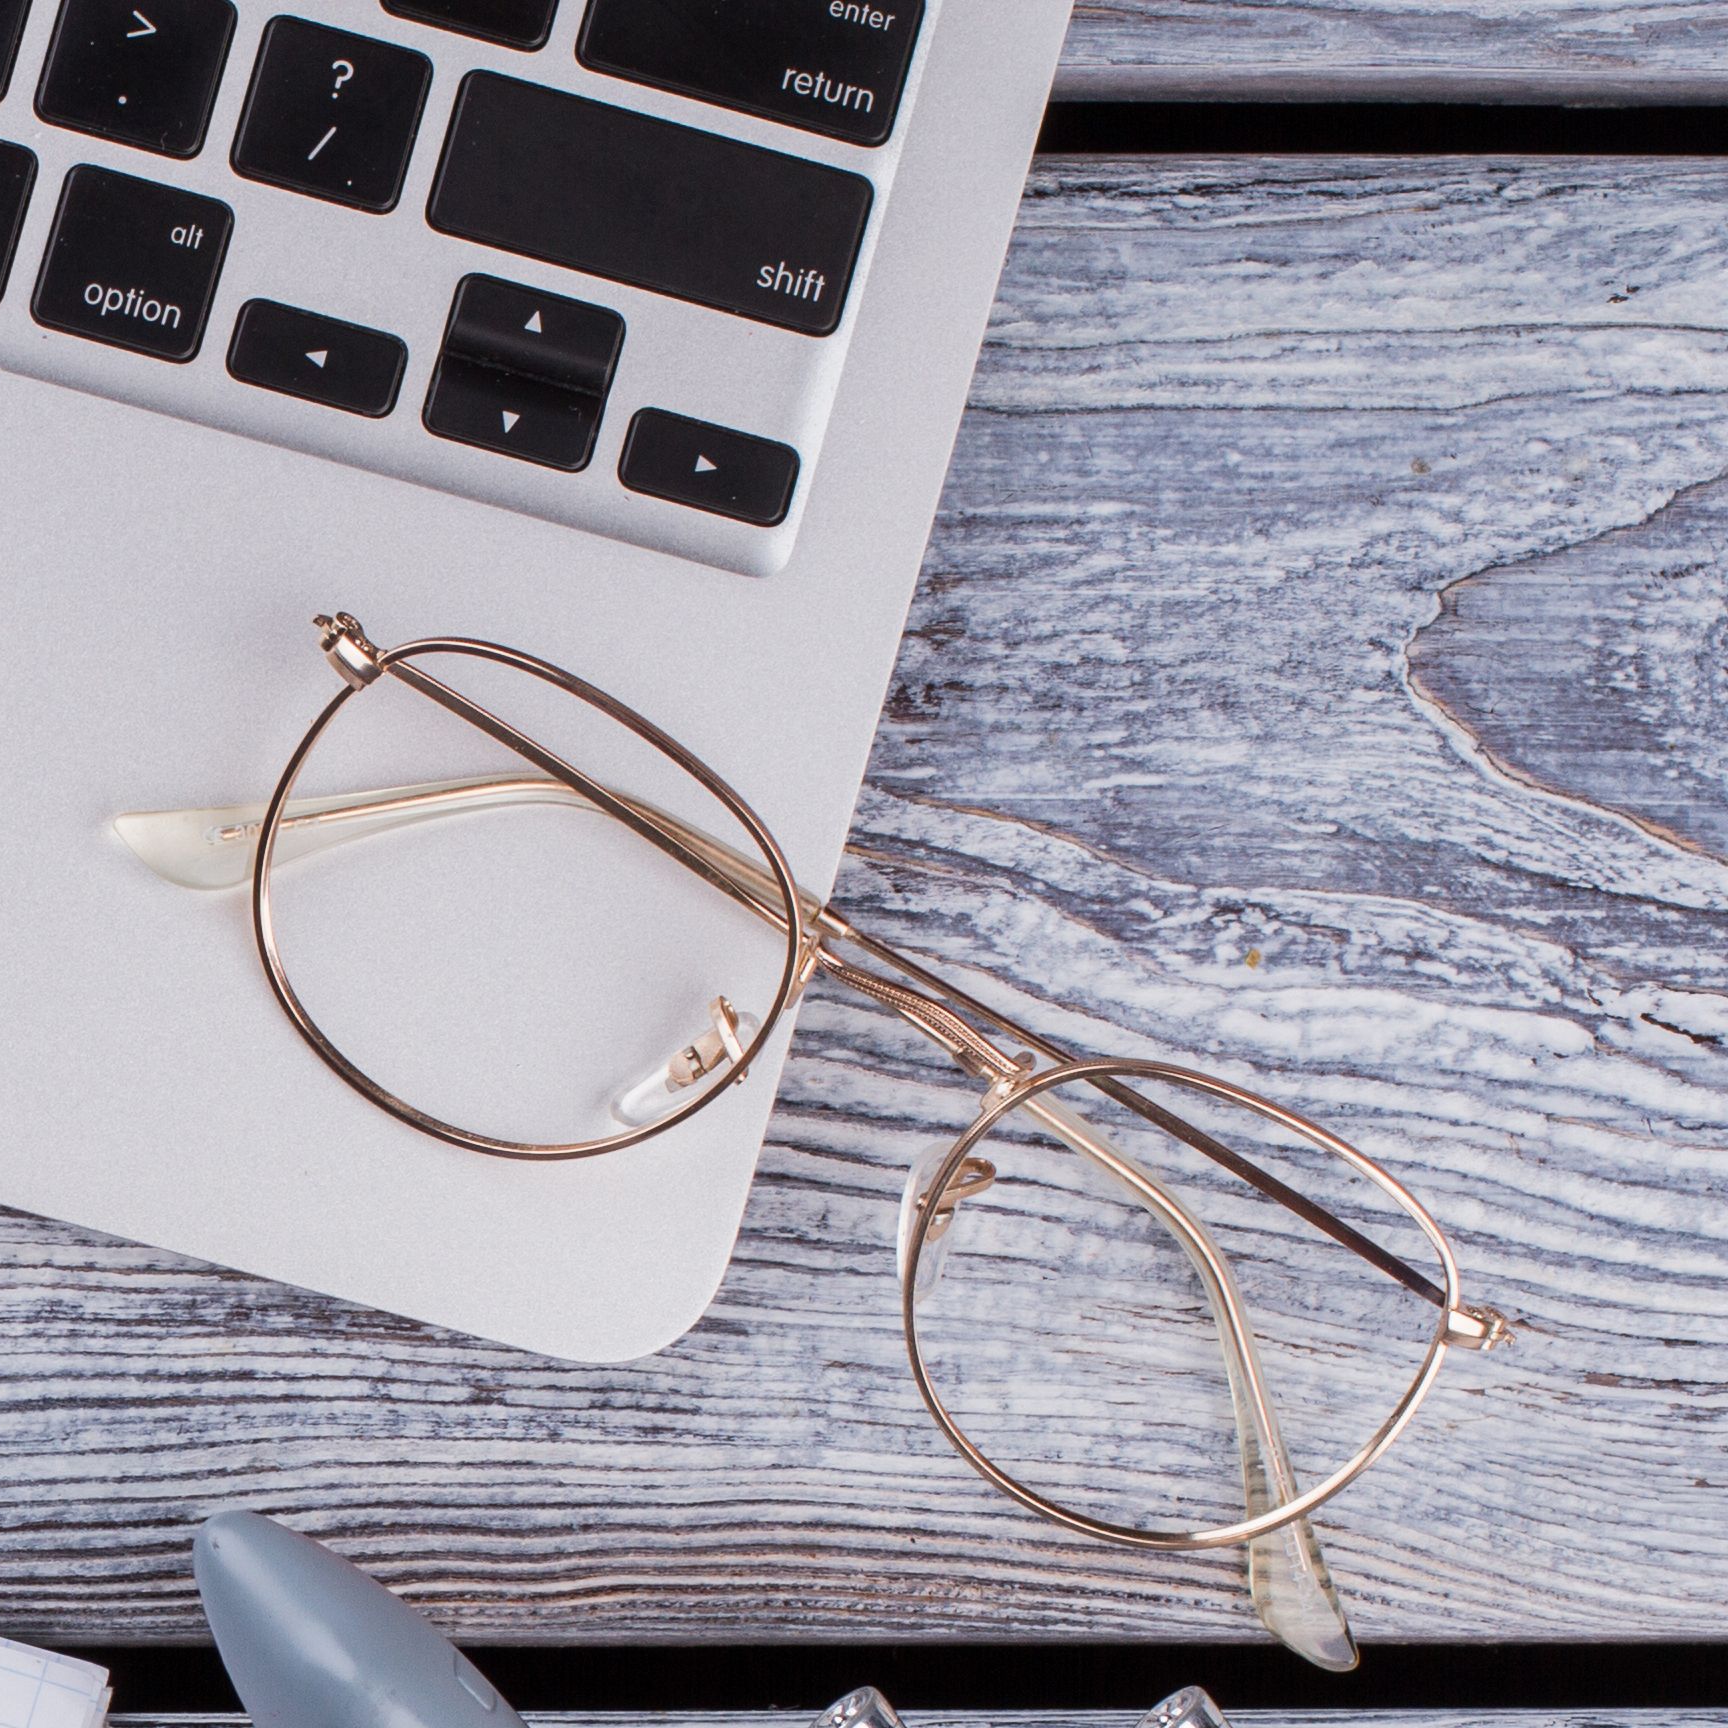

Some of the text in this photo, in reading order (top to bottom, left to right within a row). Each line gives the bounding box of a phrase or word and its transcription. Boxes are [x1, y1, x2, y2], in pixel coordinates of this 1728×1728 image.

[829, 0, 896, 31] enter
[332, 59, 354, 99] ?
[782, 68, 874, 113] return
[308, 126, 337, 160] /
[170, 224, 204, 250] alt
[756, 261, 826, 302] shift
[84, 283, 181, 329] option
